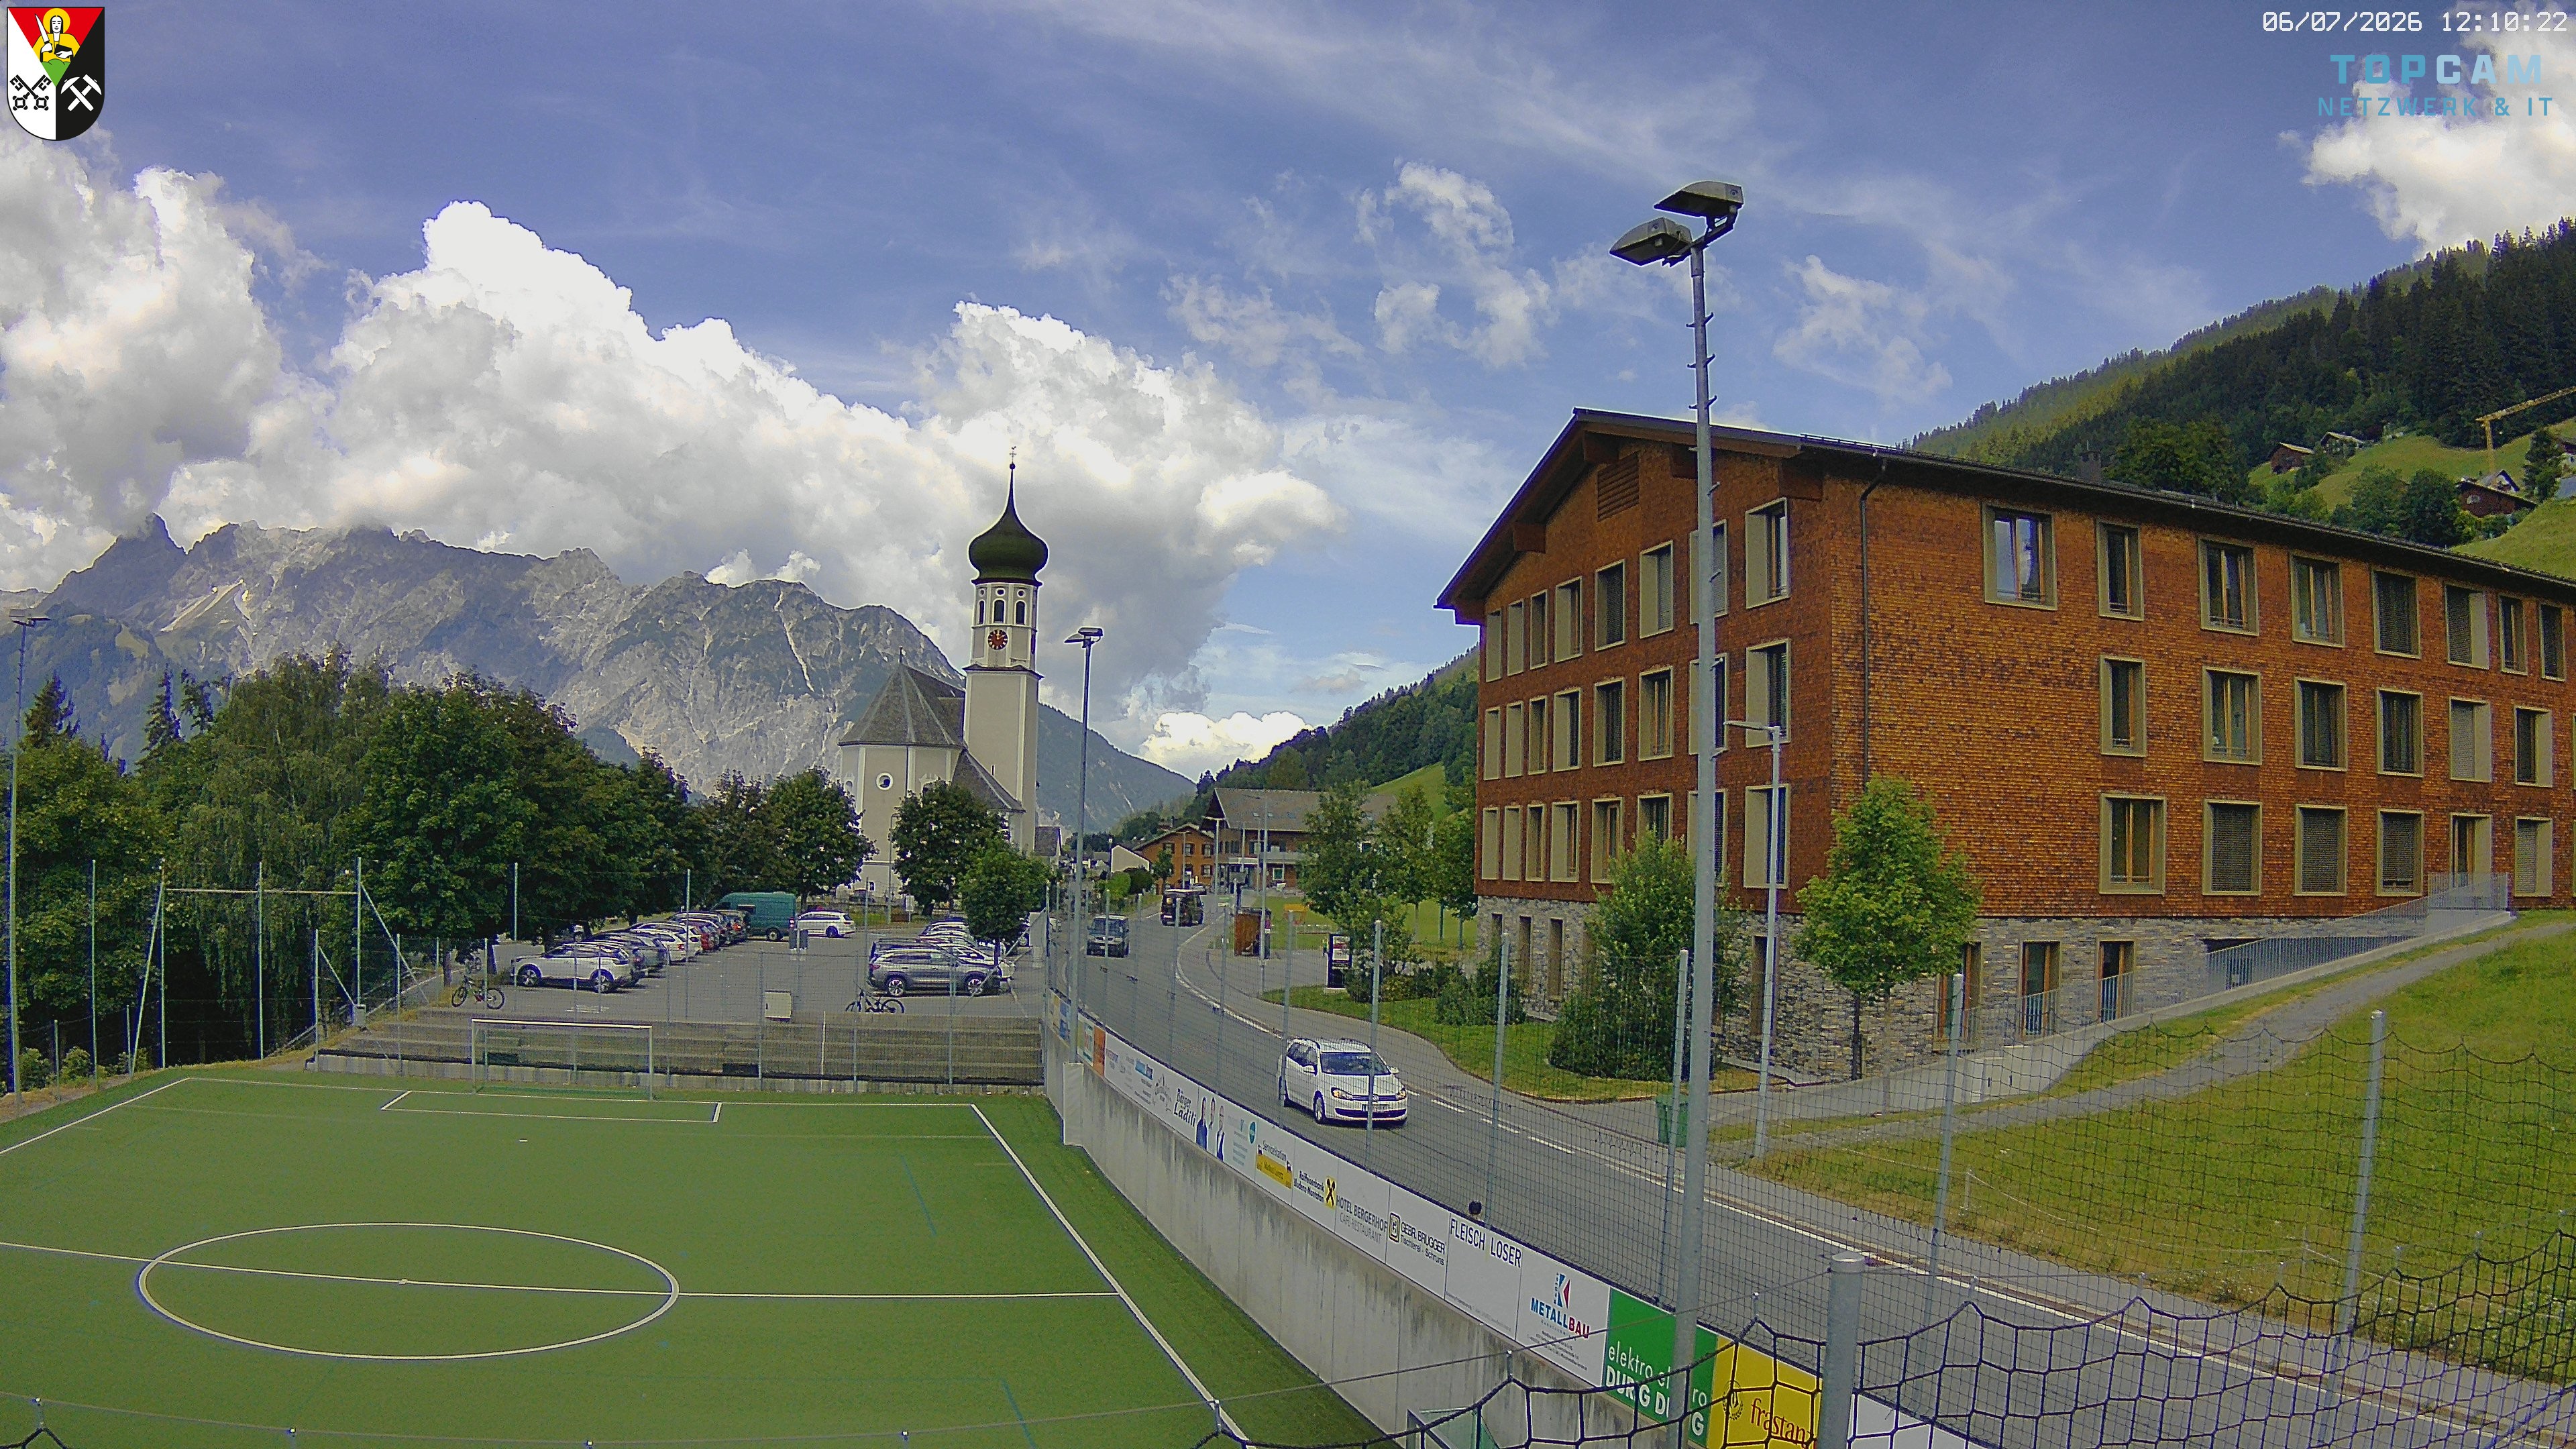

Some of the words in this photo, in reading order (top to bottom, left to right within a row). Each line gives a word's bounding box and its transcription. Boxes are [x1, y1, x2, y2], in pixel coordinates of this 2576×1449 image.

[1336, 1195, 1352, 1214] HOTEL
[1354, 1204, 1388, 1232] BERGERHOF
[1450, 1218, 1485, 1250] FLEISCH
[1491, 1237, 1521, 1268] LOSER
[1531, 1297, 1590, 1338] METALLBAU
[1608, 1341, 1653, 1379] elektro
[1606, 1365, 1651, 1407] DURG
